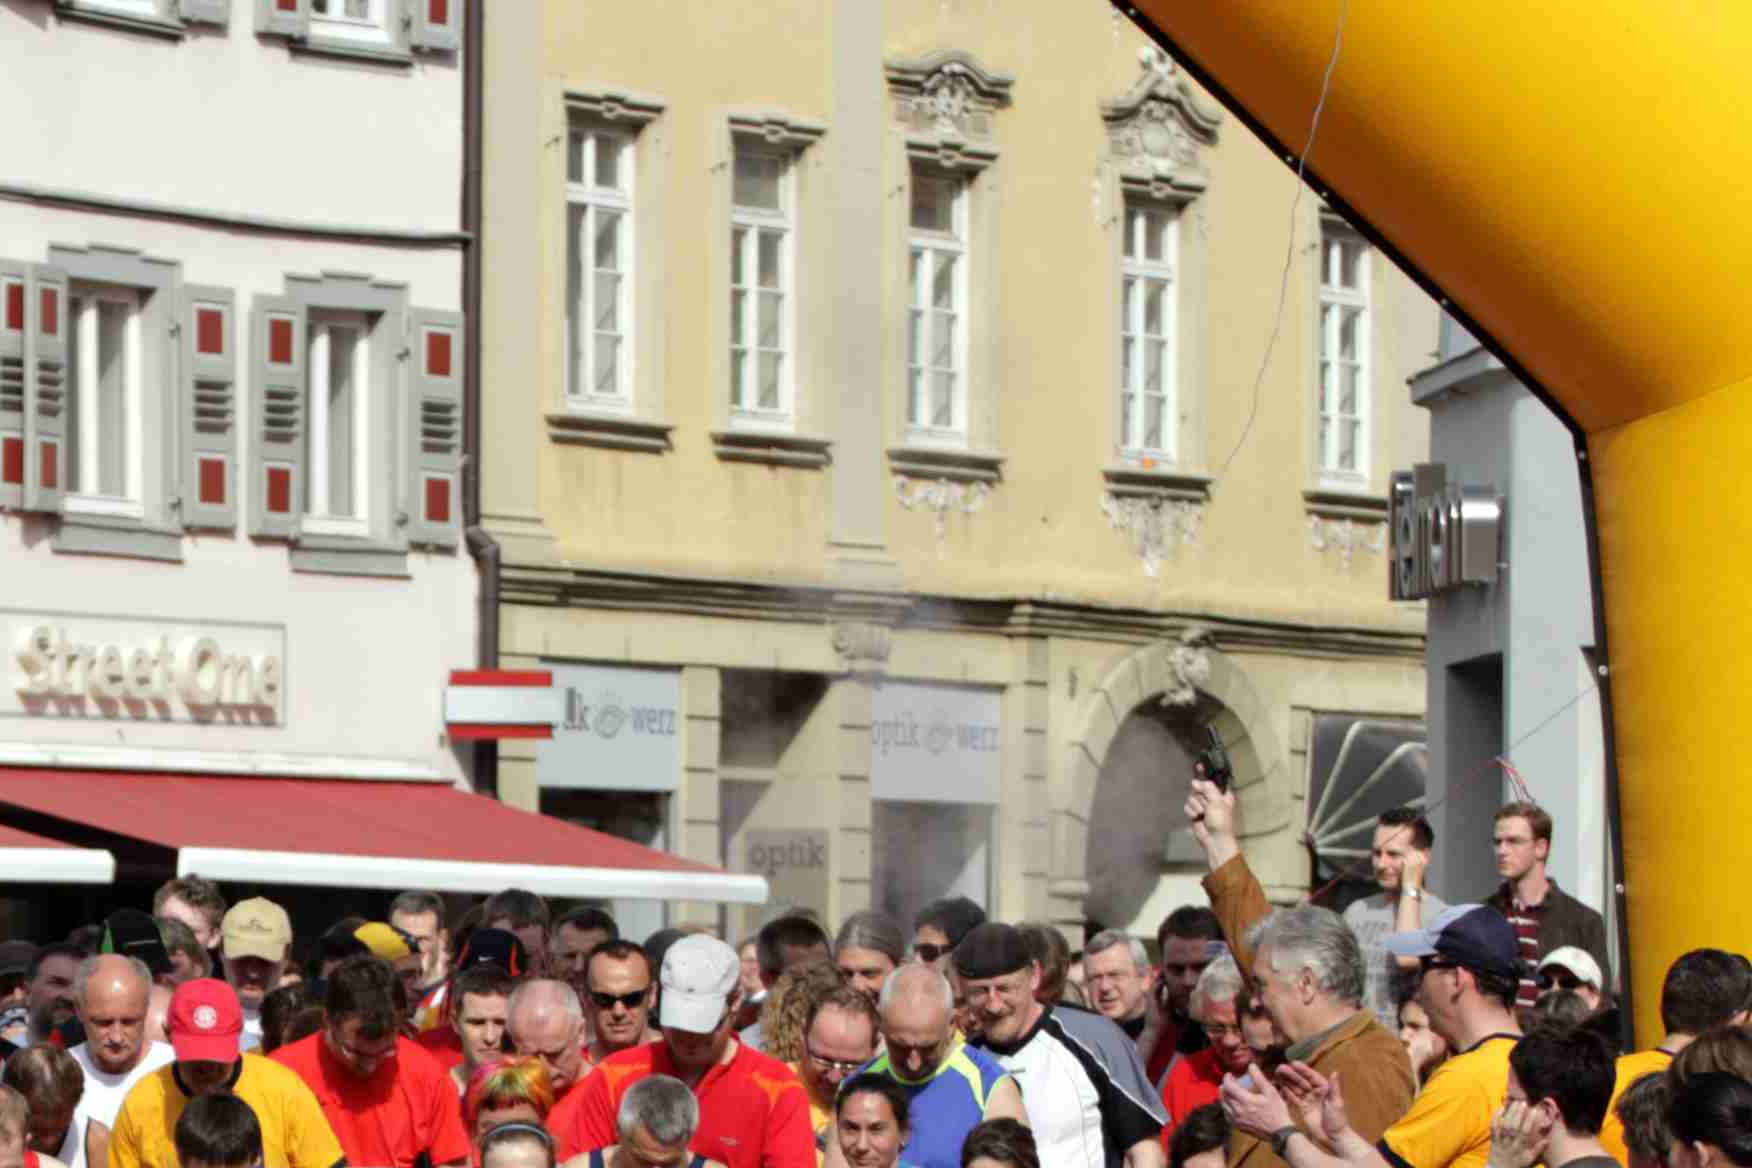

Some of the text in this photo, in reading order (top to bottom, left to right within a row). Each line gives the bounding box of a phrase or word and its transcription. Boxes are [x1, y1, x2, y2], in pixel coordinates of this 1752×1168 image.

[15, 624, 282, 712] Street One
[632, 706, 676, 735] werz
[872, 712, 919, 758] optik
[749, 836, 825, 877] optik
